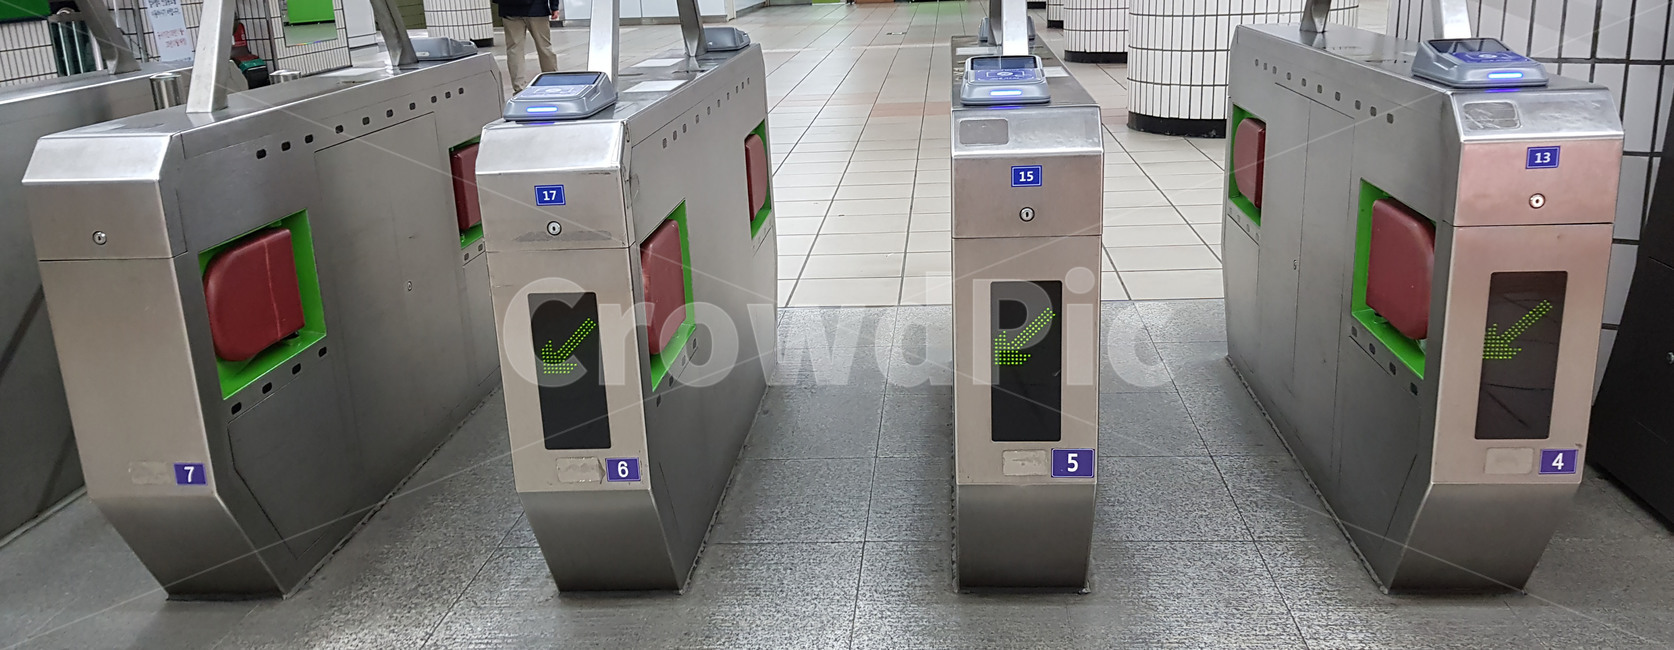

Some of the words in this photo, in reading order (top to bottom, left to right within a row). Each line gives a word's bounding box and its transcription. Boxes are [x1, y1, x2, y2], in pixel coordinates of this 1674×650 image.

[1535, 151, 1551, 164] 13
[1019, 171, 1034, 182] 15
[542, 190, 557, 201] 17
[617, 460, 629, 478] 6
[1067, 453, 1079, 473] 5
[1552, 453, 1565, 470] 4
[183, 466, 195, 483] 7
